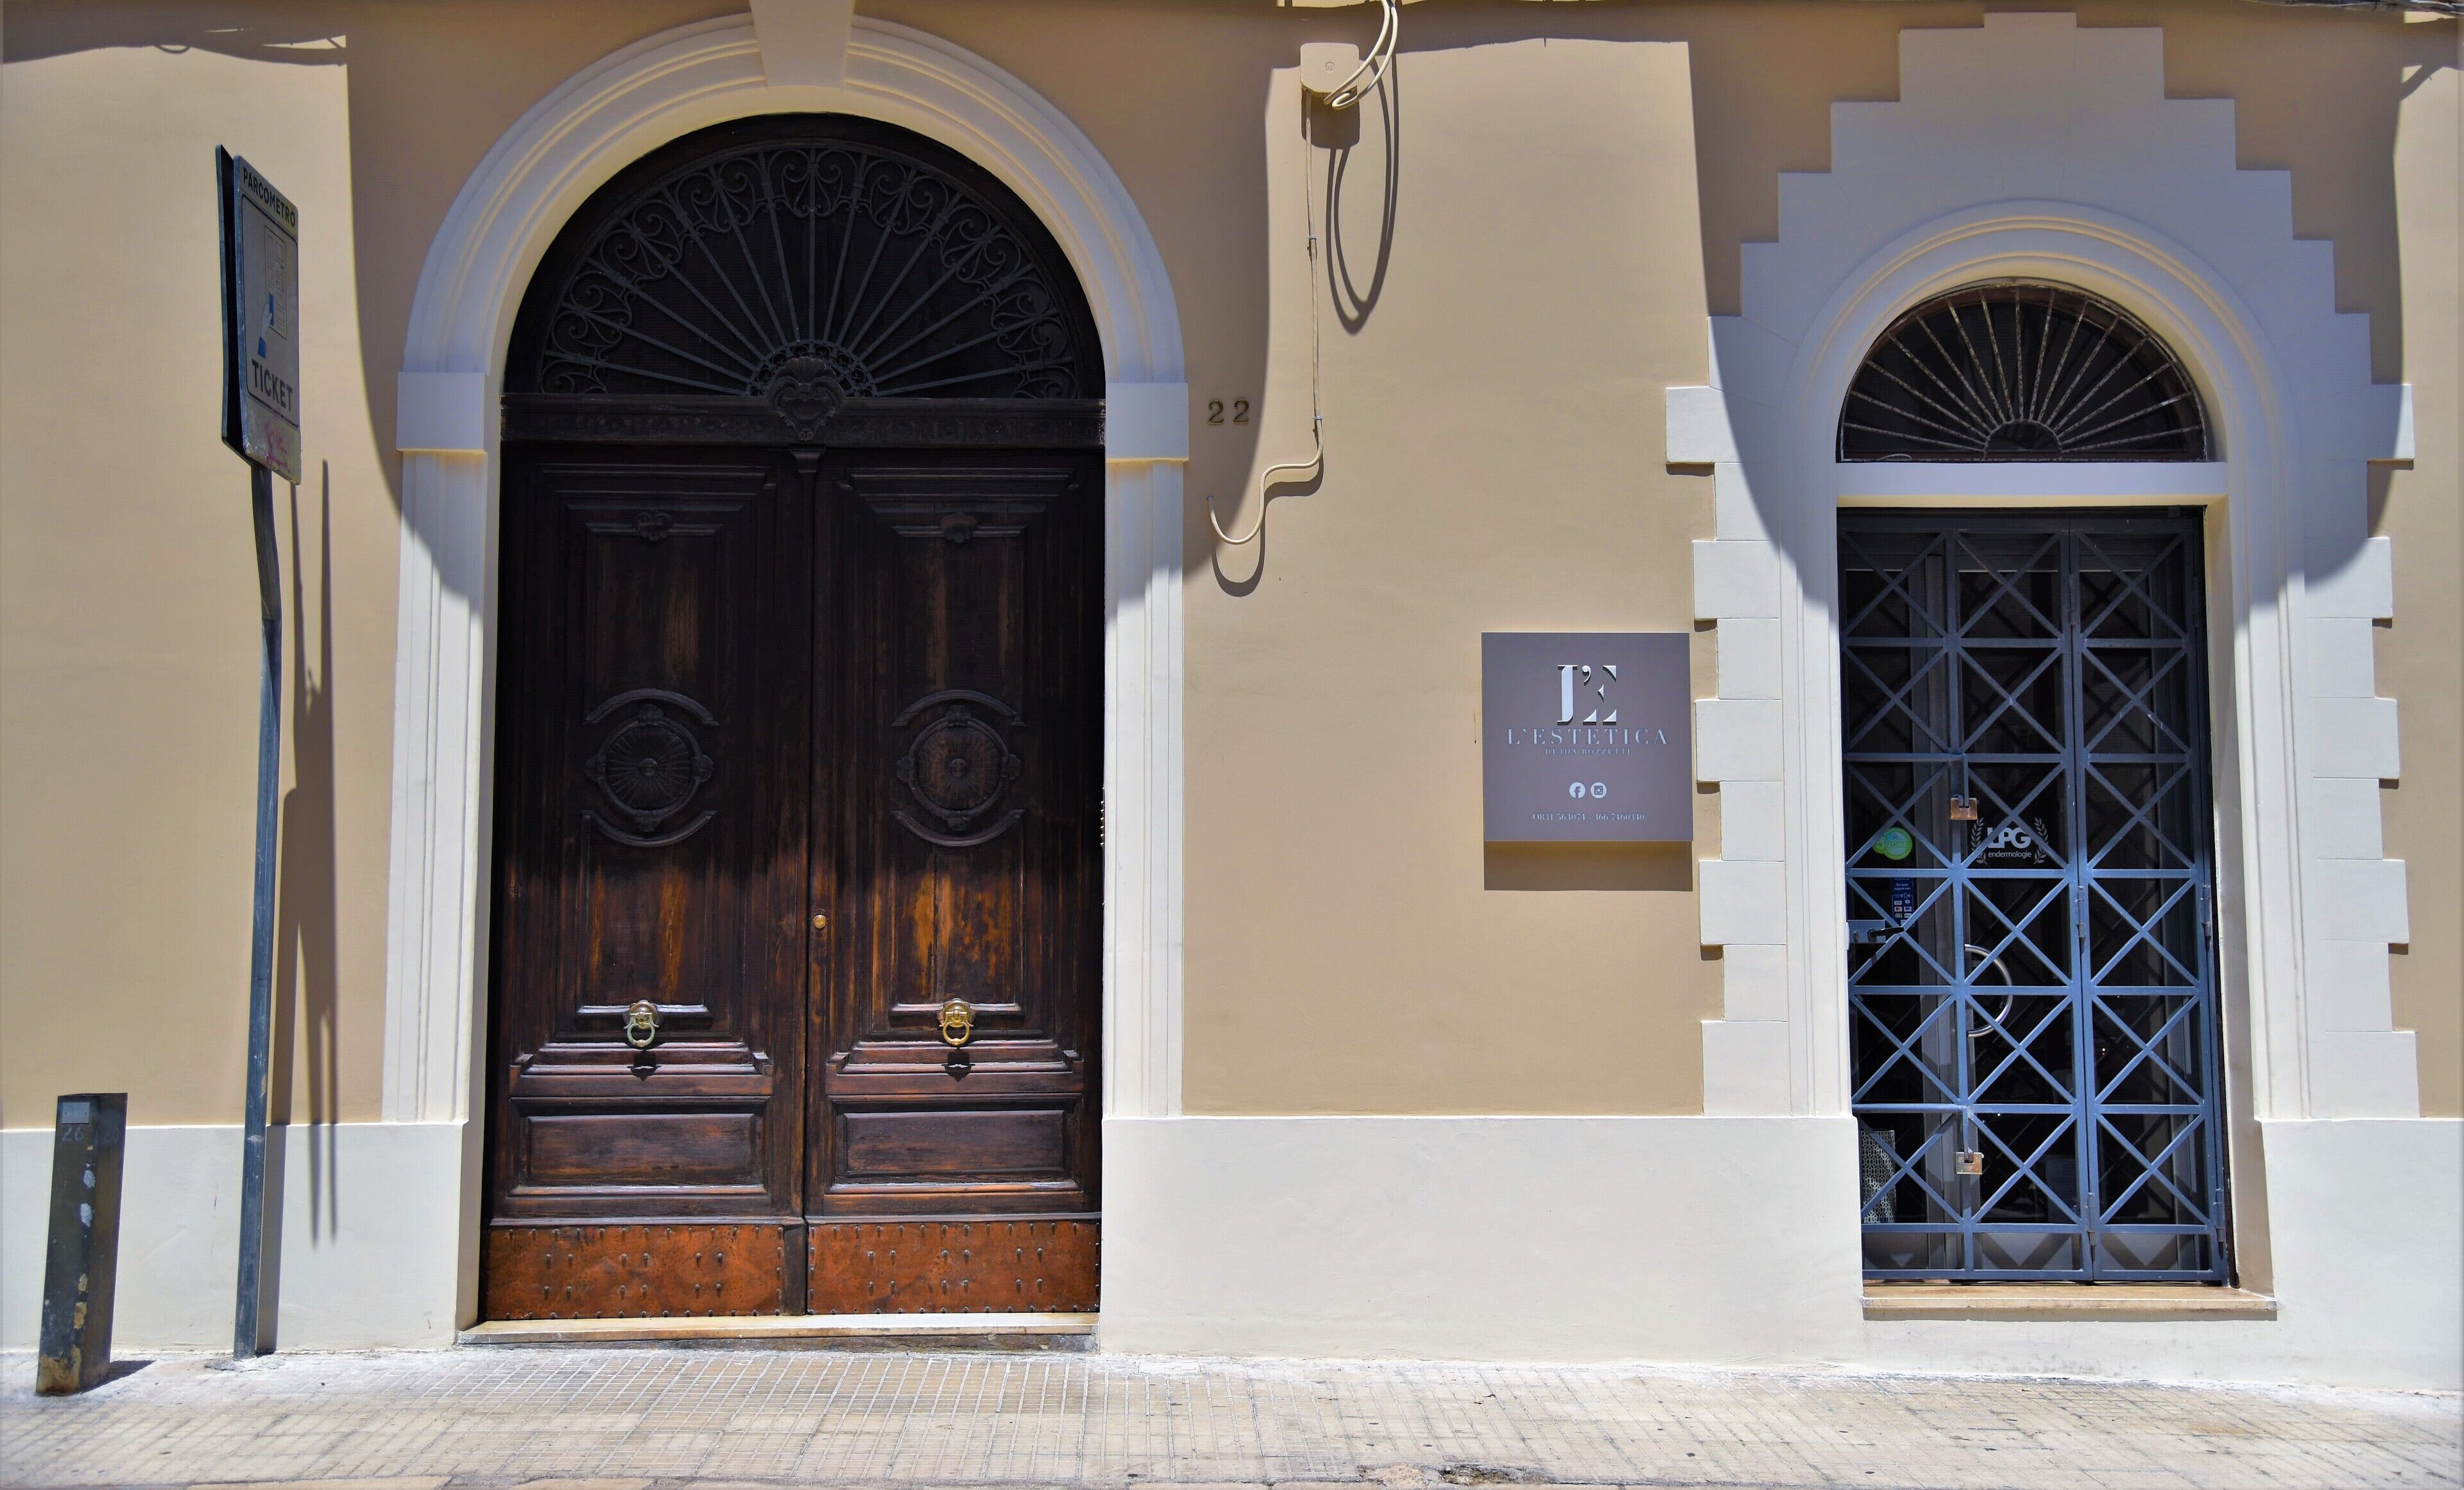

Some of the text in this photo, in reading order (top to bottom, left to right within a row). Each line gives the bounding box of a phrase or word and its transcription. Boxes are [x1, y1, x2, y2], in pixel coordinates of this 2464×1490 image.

[243, 167, 296, 227] PARCOMETRO
[252, 359, 293, 412] TICKET
[1208, 400, 1249, 424] 22
[1507, 728, 1668, 745] L'ESTETICA
[1532, 813, 1553, 821] 0831
[1987, 827, 2032, 848] LPG
[1988, 850, 2032, 859] endermologie
